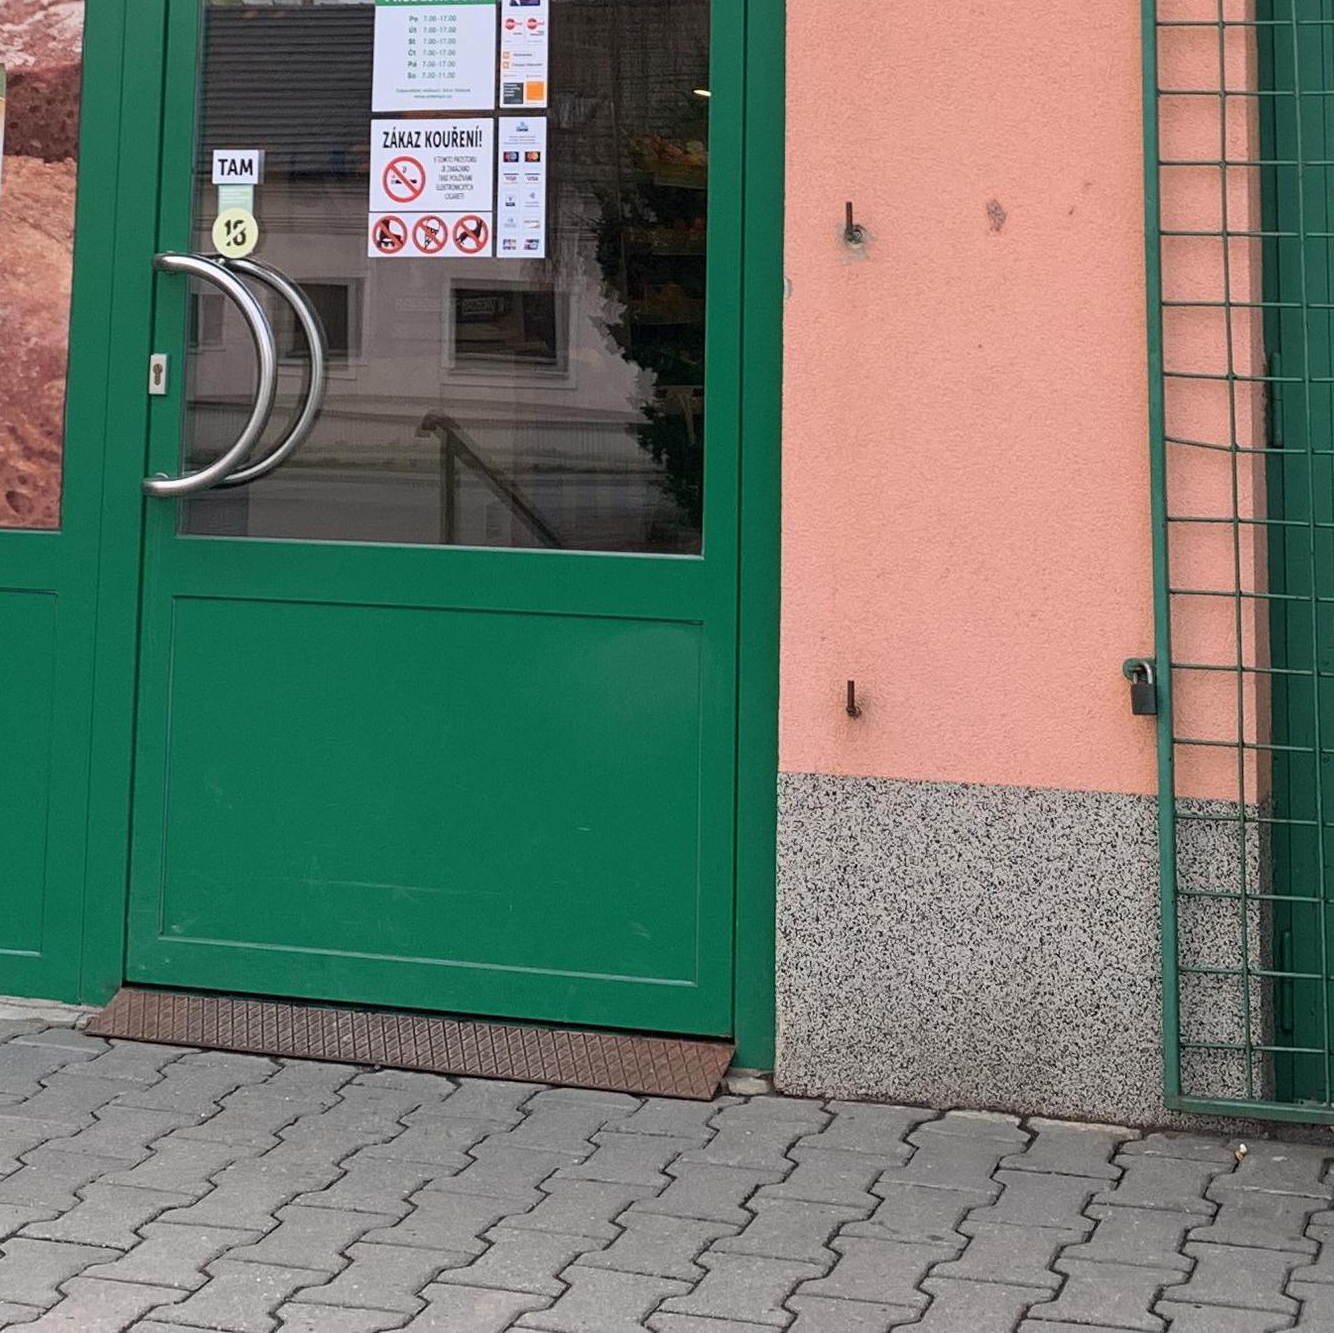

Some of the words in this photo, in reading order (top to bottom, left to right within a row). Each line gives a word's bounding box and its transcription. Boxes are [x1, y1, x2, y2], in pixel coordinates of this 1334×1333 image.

[382, 126, 421, 149] ZÁKAZ
[424, 125, 483, 149] KOUŘENÍ!
[217, 158, 254, 176] TAM
